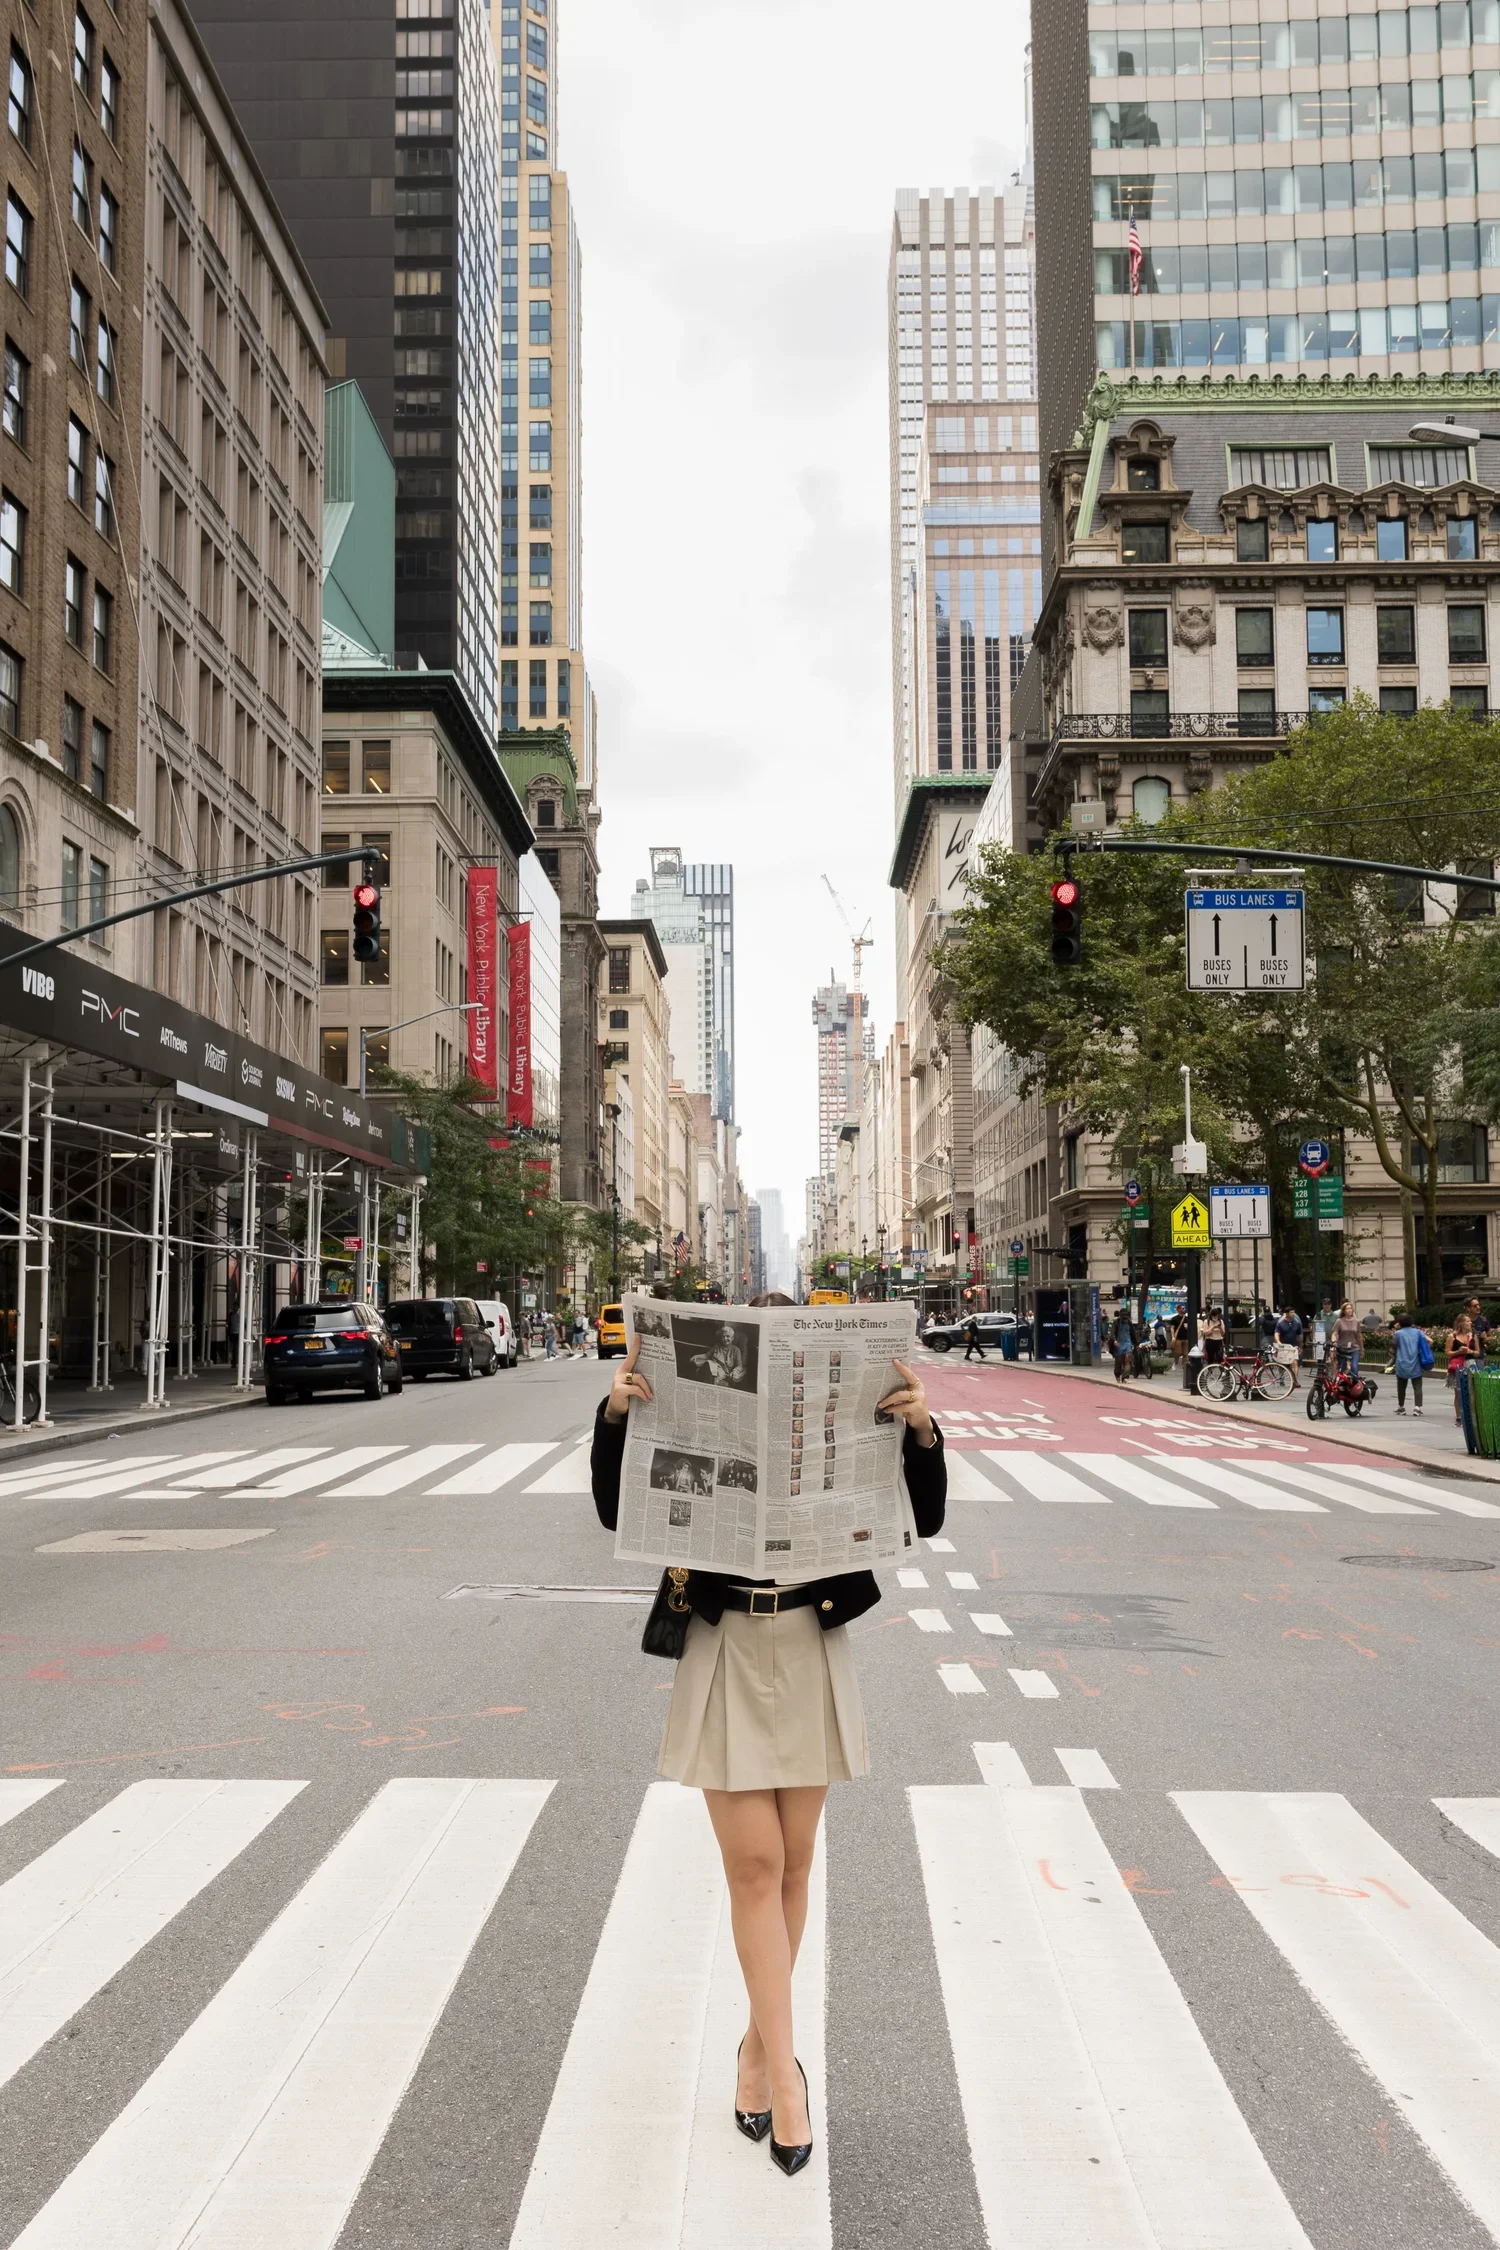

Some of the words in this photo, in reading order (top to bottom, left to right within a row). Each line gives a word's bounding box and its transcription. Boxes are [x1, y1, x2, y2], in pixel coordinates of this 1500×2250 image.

[475, 884, 490, 917] New
[1215, 894, 1236, 906] BUS
[1240, 894, 1275, 906] LANES
[475, 923, 490, 953] York
[515, 938, 527, 967] New
[1203, 959, 1232, 971] BUSES
[1260, 959, 1289, 971] BUSES
[475, 960, 490, 1002] Public
[515, 969, 527, 1000] York
[1205, 974, 1230, 985] ONLY
[1262, 974, 1287, 985] ONLY
[81, 988, 140, 1038] PMC
[515, 1004, 527, 1041] Public
[159, 1026, 188, 1055] ARTnews
[472, 1006, 490, 1064] Library
[248, 1064, 263, 1078] SOURCING
[511, 1046, 529, 1096] Library
[248, 1074, 262, 1088] JOURNAL
[305, 1089, 334, 1119] PMC
[1294, 1179, 1308, 1188] x27
[1294, 1190, 1308, 1198] x28
[1294, 1199, 1309, 1207] x37
[1294, 1209, 1309, 1217] x38
[1175, 1235, 1208, 1243] AHEAD
[793, 1318, 812, 1331] The
[812, 1318, 834, 1330] New
[834, 1318, 858, 1332] York
[858, 1318, 888, 1329] Times
[1099, 1416, 1257, 1433] ONLY
[942, 1426, 1065, 1441] BUS
[1152, 1432, 1310, 1452] BUS
